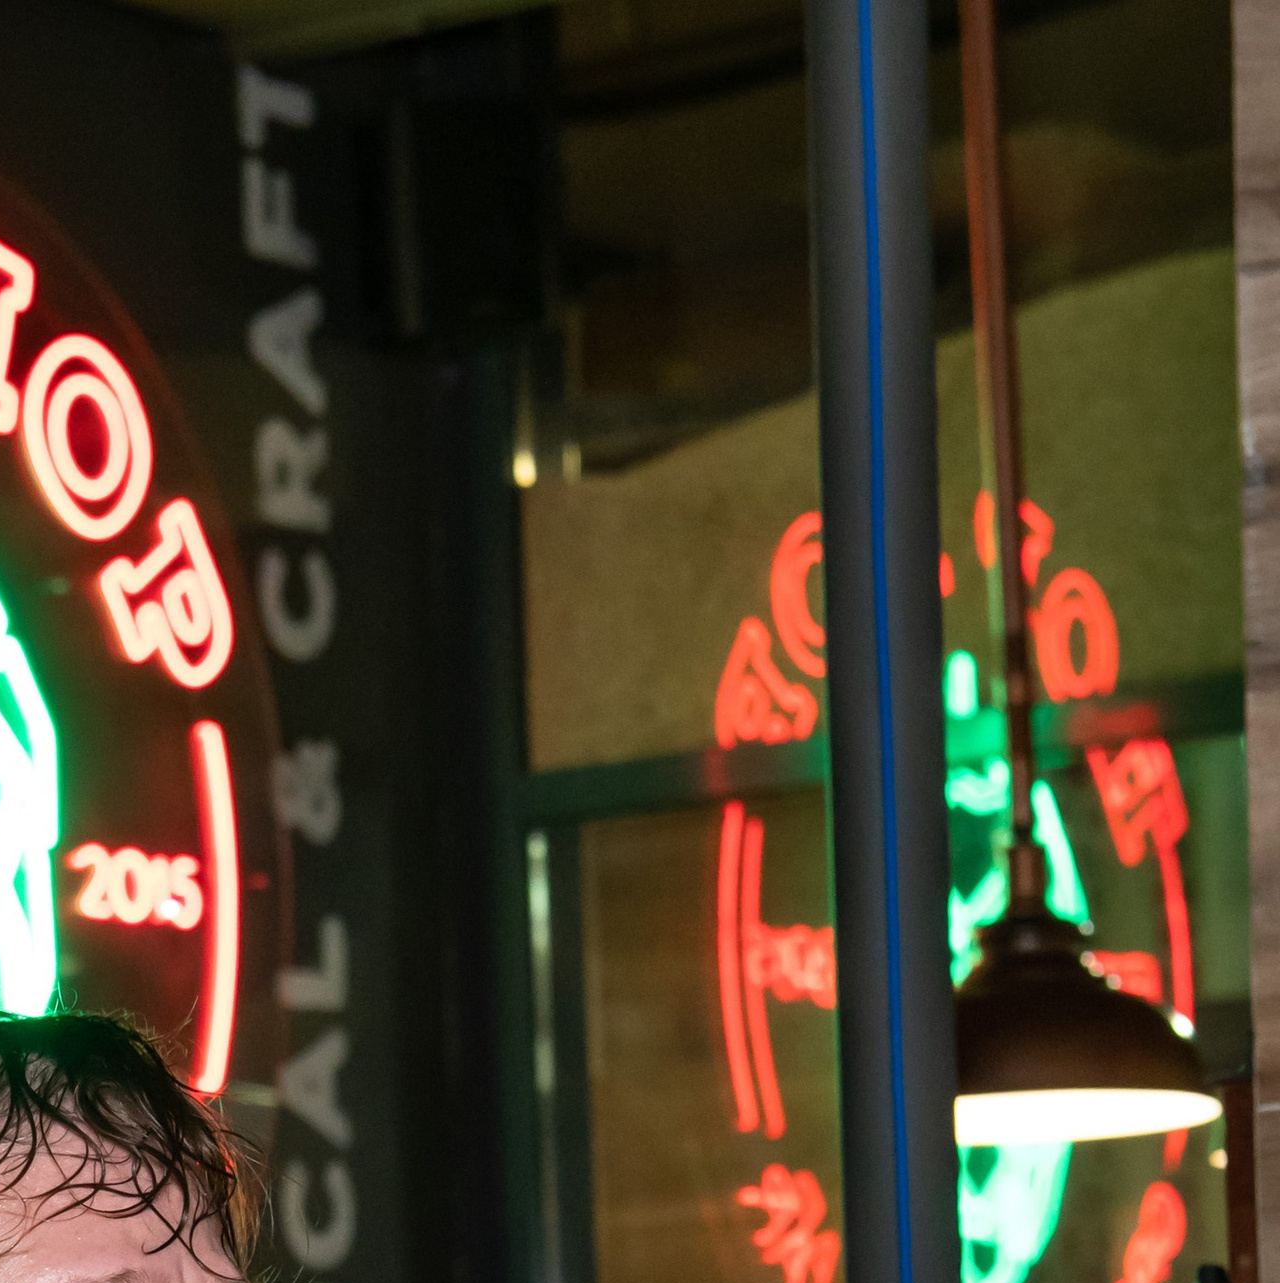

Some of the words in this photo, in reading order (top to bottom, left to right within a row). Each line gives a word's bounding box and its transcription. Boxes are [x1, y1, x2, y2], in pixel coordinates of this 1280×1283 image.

[236, 60, 338, 662] CRAFT
[271, 739, 344, 848] &
[64, 841, 203, 931] 2015
